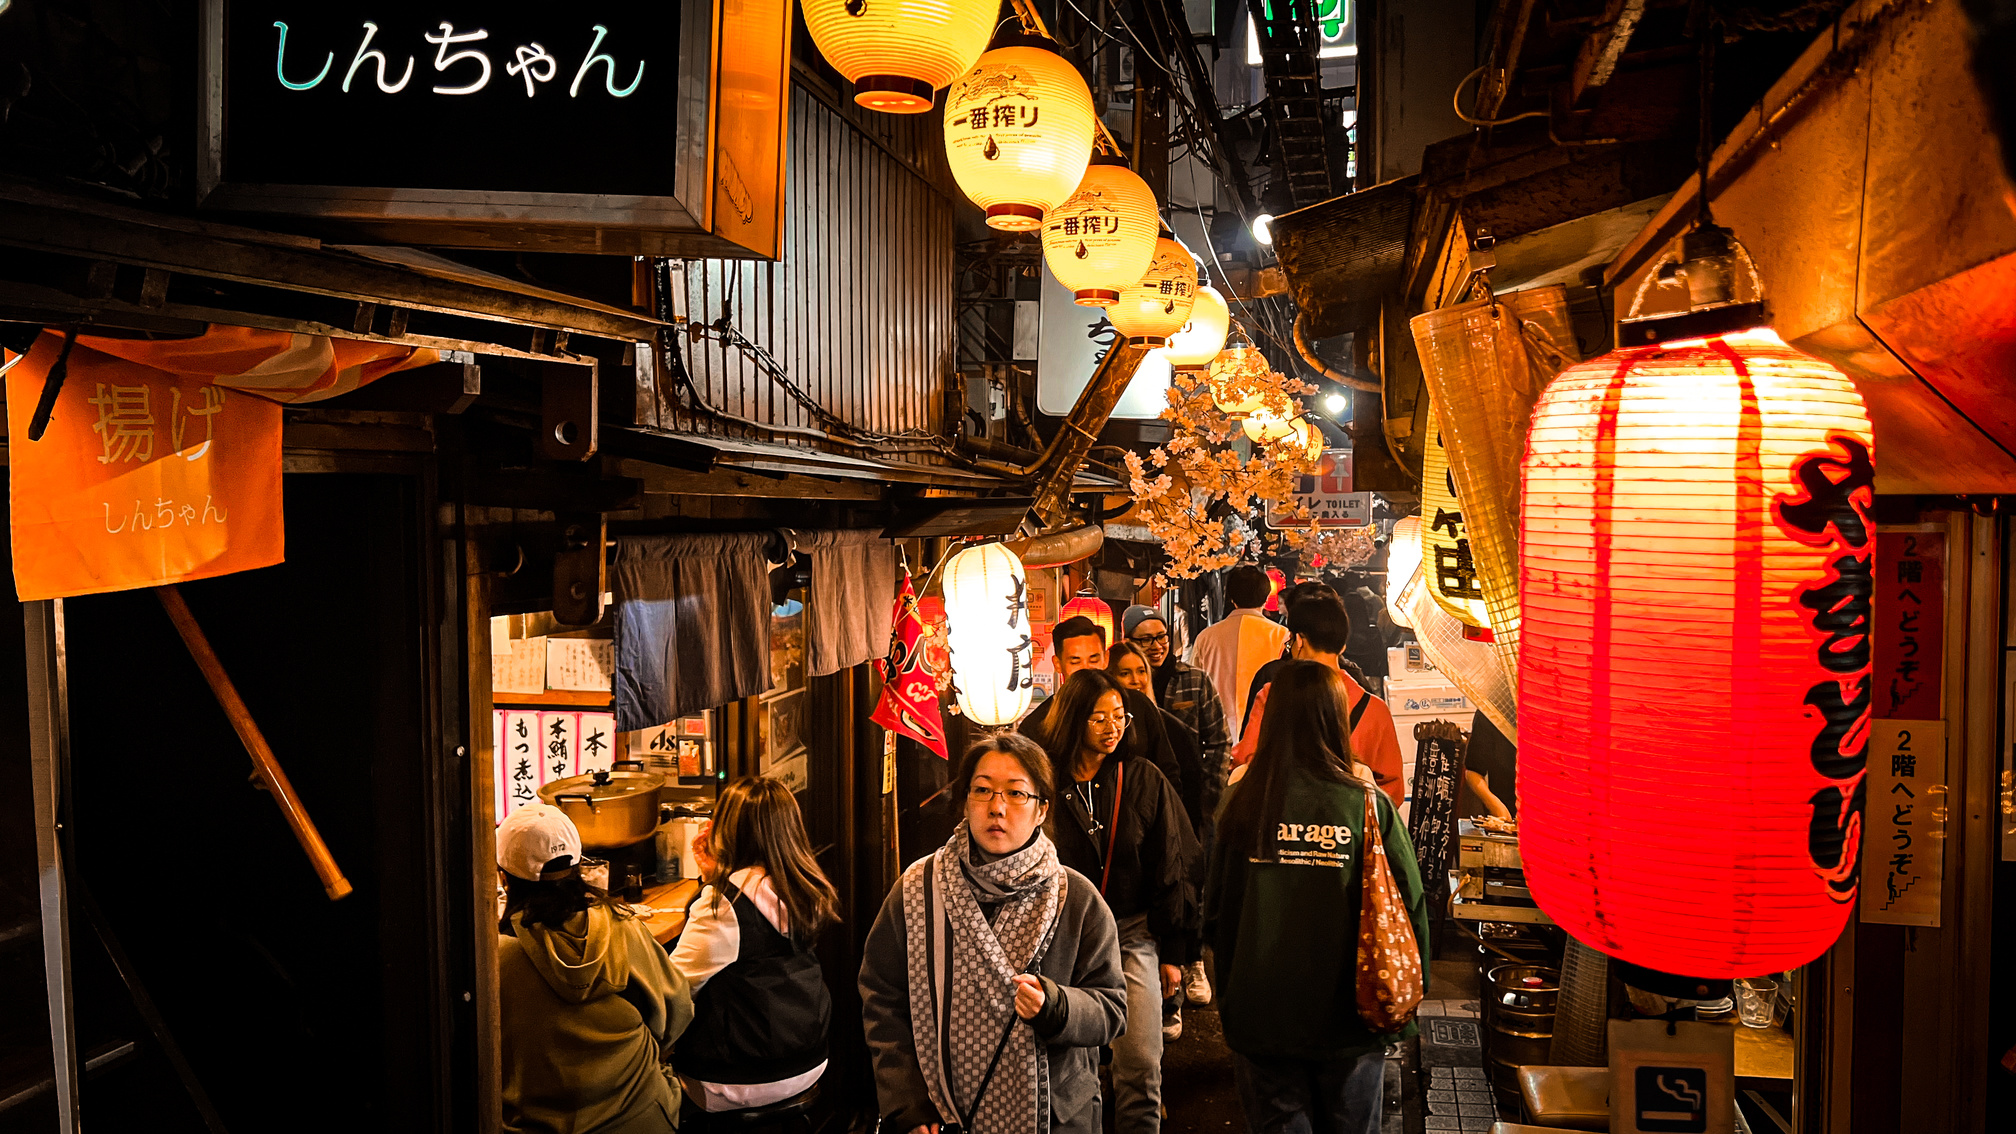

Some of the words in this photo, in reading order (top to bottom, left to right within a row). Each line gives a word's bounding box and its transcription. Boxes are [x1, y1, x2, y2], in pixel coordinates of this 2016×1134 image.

[273, 21, 645, 98] しんちゃん
[953, 104, 1039, 130] 一番搾り
[1049, 215, 1119, 236] 一番搾り
[1142, 279, 1194, 298] 一番搾り
[88, 382, 226, 463] 揚げ
[103, 495, 228, 534] しんちゃん
[1326, 500, 1360, 508] TOILET
[1896, 536, 1923, 684] 2階へどうぞ
[512, 718, 535, 806] もつ煮込
[547, 717, 569, 780] 本鮪中
[1889, 730, 1916, 875] 2階へどうぞ
